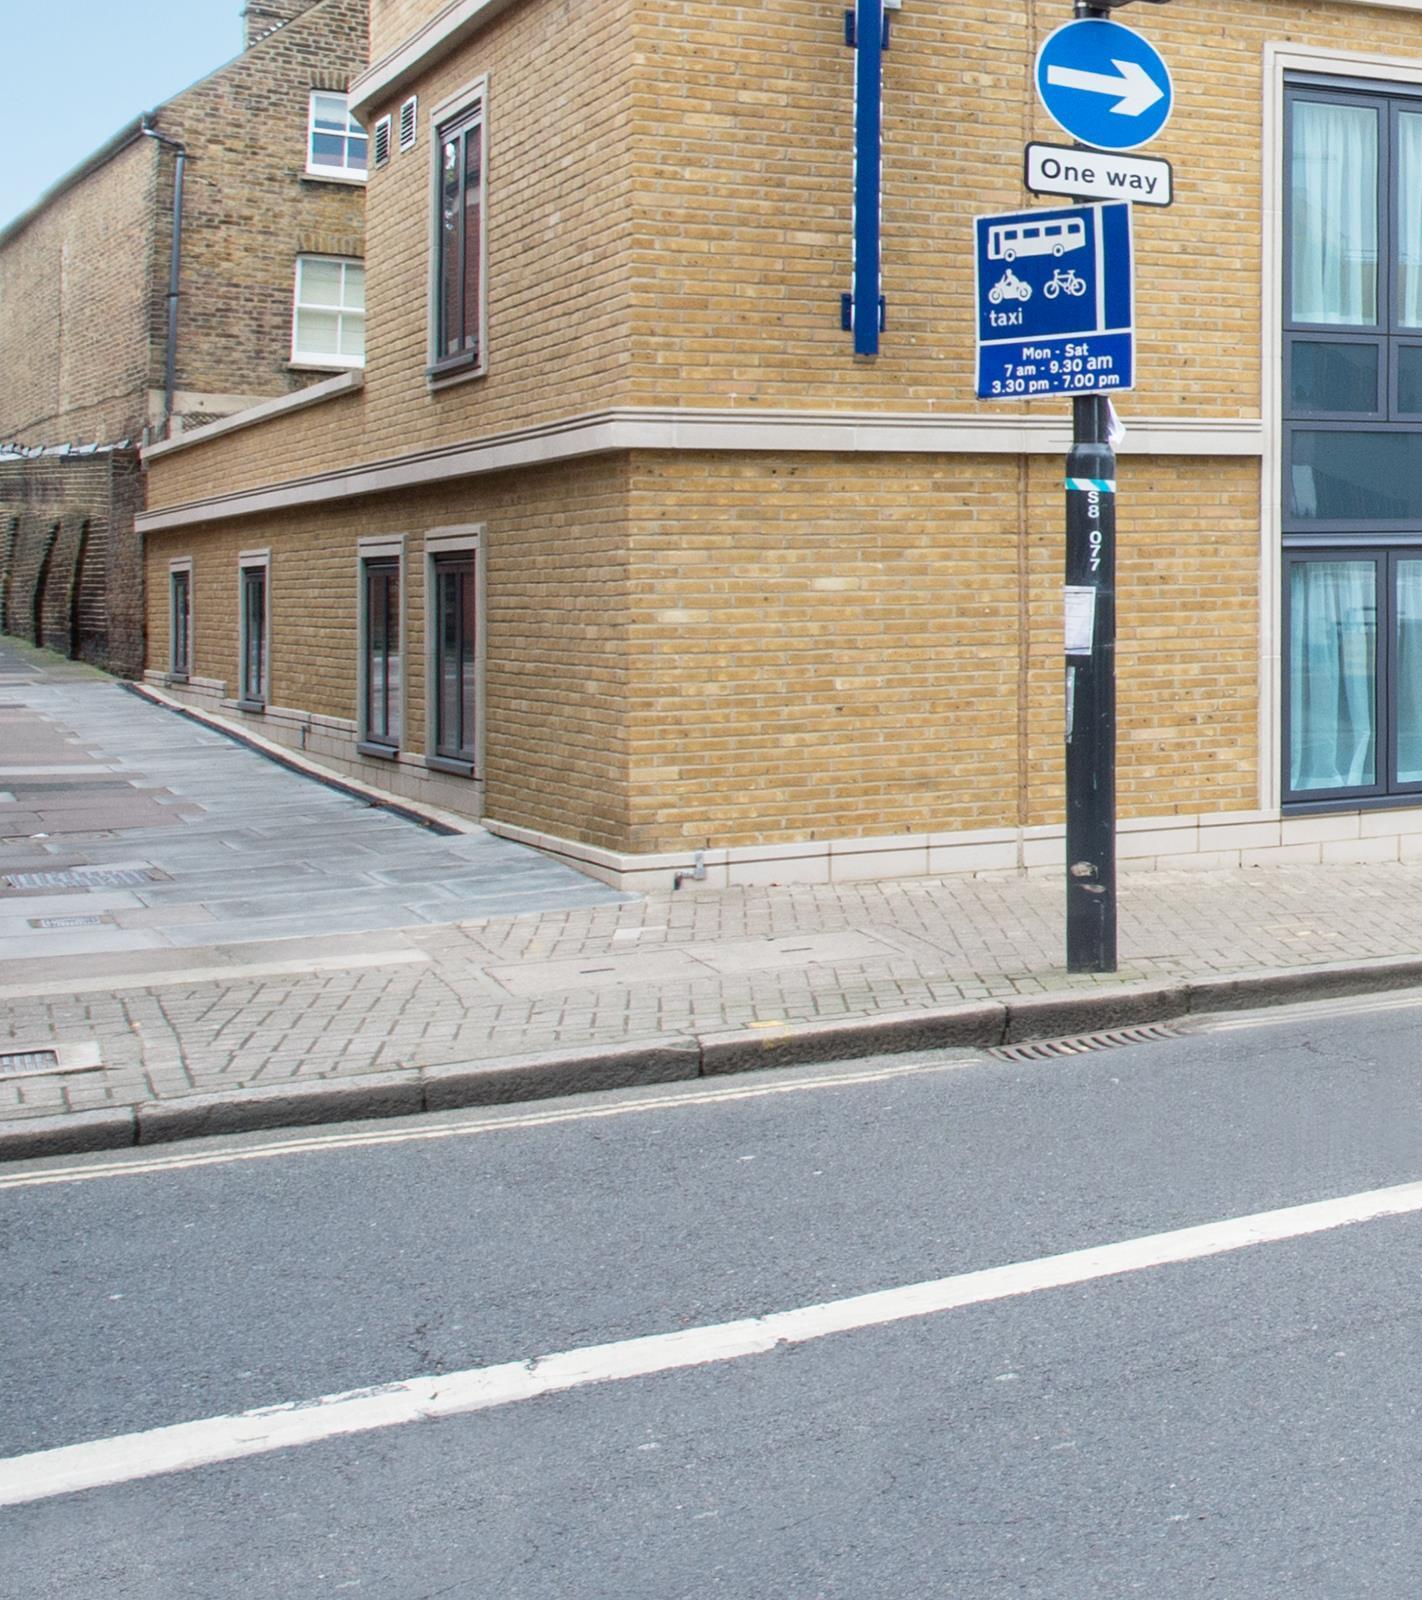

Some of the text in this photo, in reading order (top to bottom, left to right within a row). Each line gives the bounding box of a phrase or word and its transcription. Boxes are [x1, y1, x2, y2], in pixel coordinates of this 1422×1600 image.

[1041, 158, 1157, 194] One way
[989, 307, 1023, 327] taxi
[1022, 347, 1051, 361] Mon
[1064, 343, 1089, 357] Sat
[1004, 364, 1013, 377] 7
[1016, 365, 1036, 376] am
[1050, 359, 1082, 374] 9.30
[1086, 355, 1113, 370] am
[992, 379, 1025, 394] 3.30
[1029, 378, 1049, 393] pm
[1062, 373, 1095, 389] 7.00
[1099, 373, 1120, 387] pm
[1087, 491, 1102, 572] S8 077
